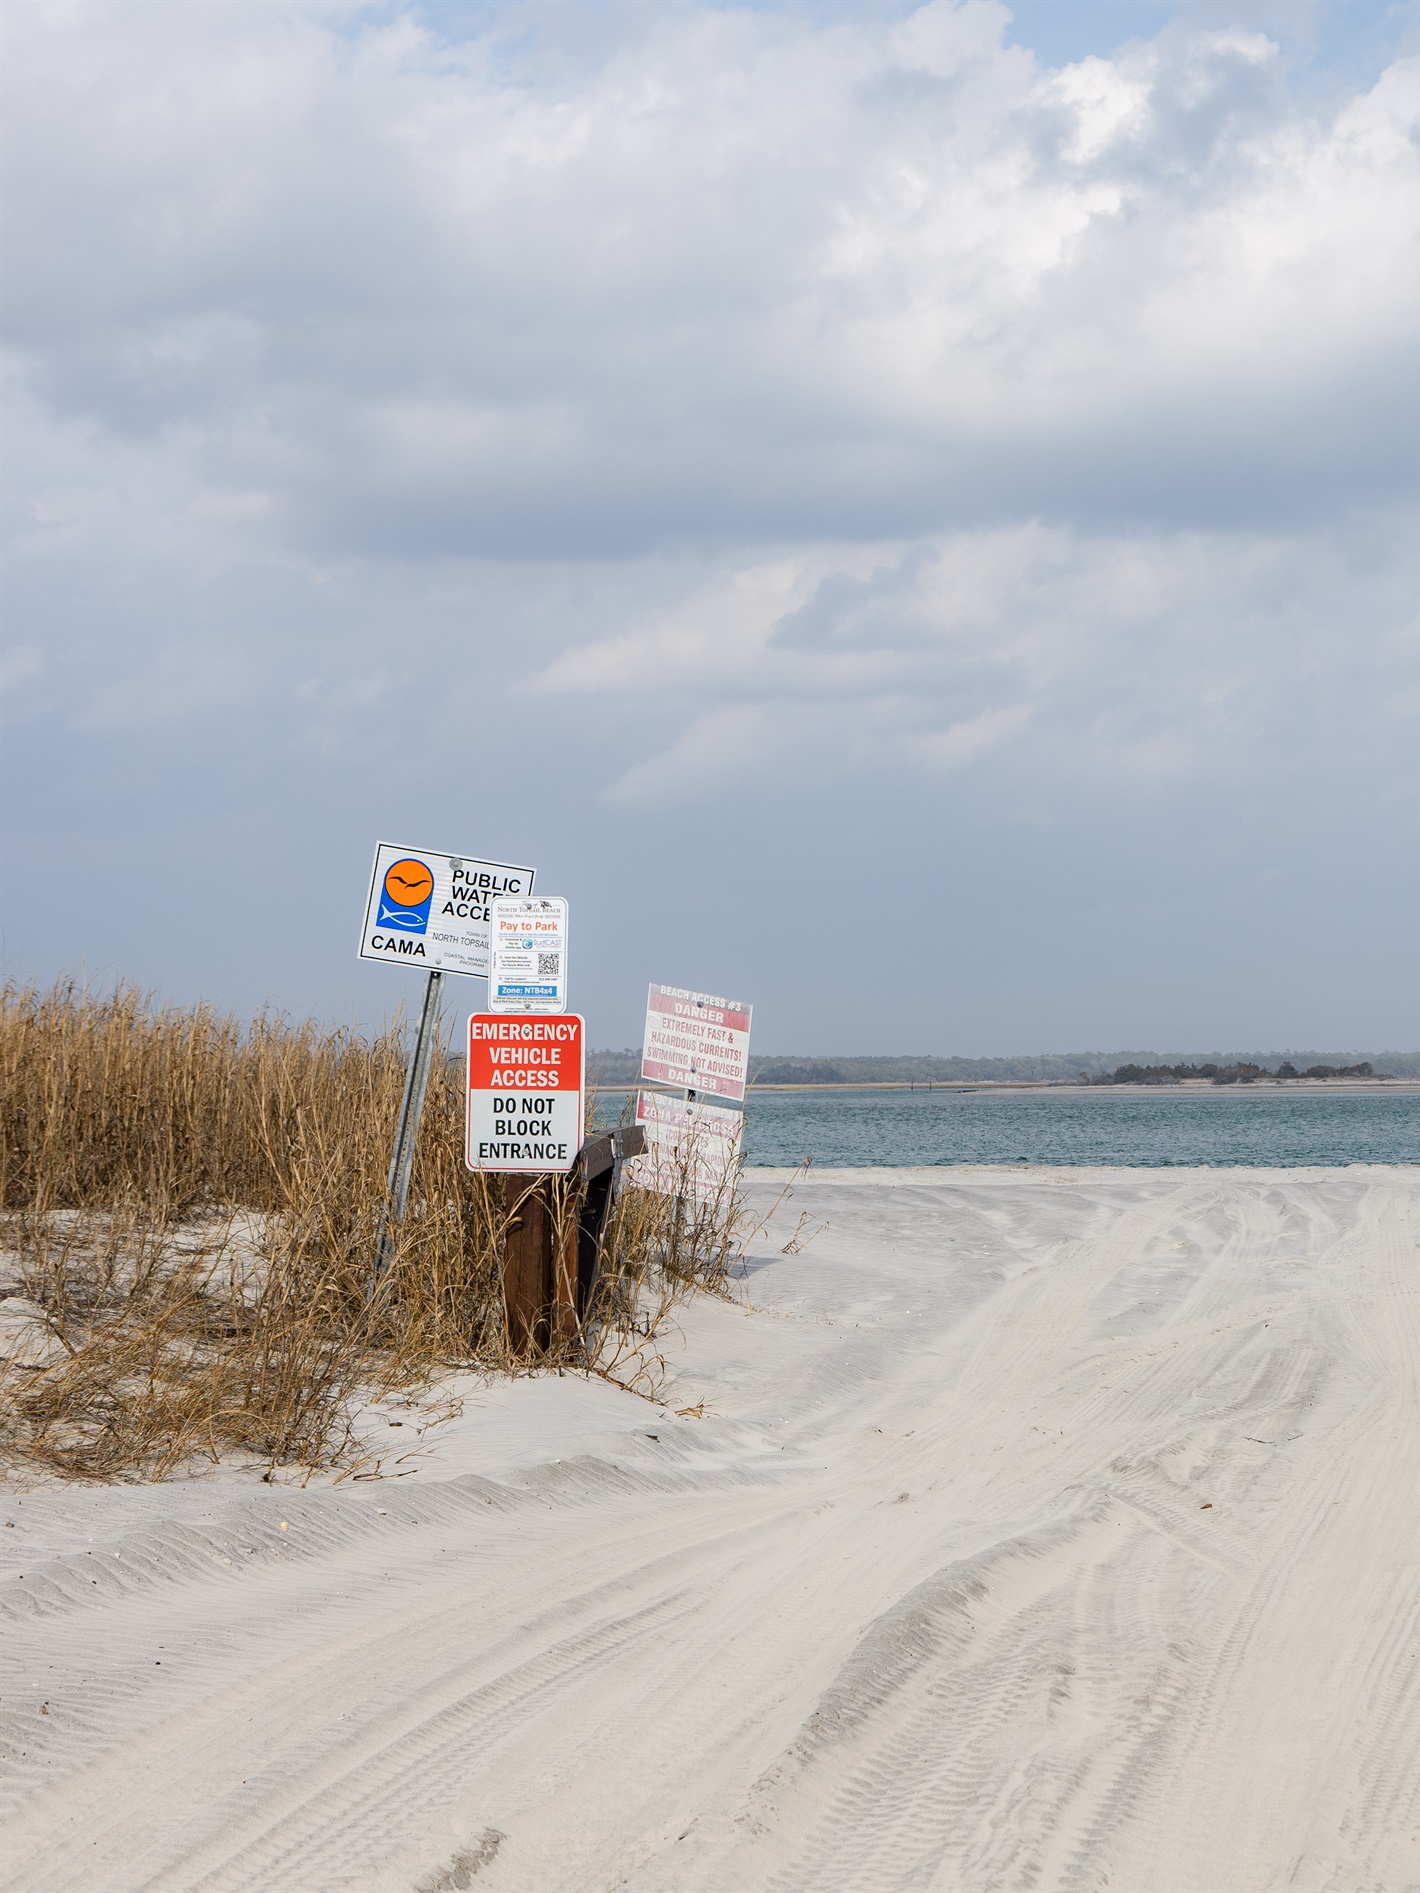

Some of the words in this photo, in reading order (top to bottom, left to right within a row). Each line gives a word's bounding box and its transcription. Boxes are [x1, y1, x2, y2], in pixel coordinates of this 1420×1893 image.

[452, 870, 521, 894] PUBLIC
[452, 885, 512, 904] WAT
[500, 921, 518, 932] Pay
[521, 922, 532, 931] to
[535, 922, 558, 931] Park
[372, 935, 426, 957] CAMA
[433, 932, 458, 944] NORTH
[460, 937, 489, 949] TOPSAIL
[444, 952, 465, 960] COASTAL
[459, 960, 485, 968] PROGRAM
[660, 985, 689, 1000] BEACH
[691, 992, 726, 1009] ACCESS
[727, 1000, 741, 1012] #3
[674, 1003, 724, 1023] DANGER
[472, 1023, 578, 1041] EMERGENCY
[662, 1017, 705, 1038] EXTREMELY
[707, 1028, 726, 1042] FAST
[728, 1032, 734, 1044] &
[651, 1031, 696, 1051] HAZARDOUS
[699, 1042, 742, 1062] CURRENTS!
[489, 1047, 561, 1065] VEHICLE
[647, 1046, 688, 1066] SWIMMING
[690, 1056, 706, 1070] NOT
[708, 1060, 742, 1078] ADVISED!
[490, 1070, 559, 1087] ACCESS
[668, 1068, 717, 1090] DANGER
[493, 1098, 516, 1114] DO
[522, 1098, 555, 1114] NOT
[495, 1120, 552, 1136] BLOCK
[479, 1143, 567, 1160] ENTRANCE
